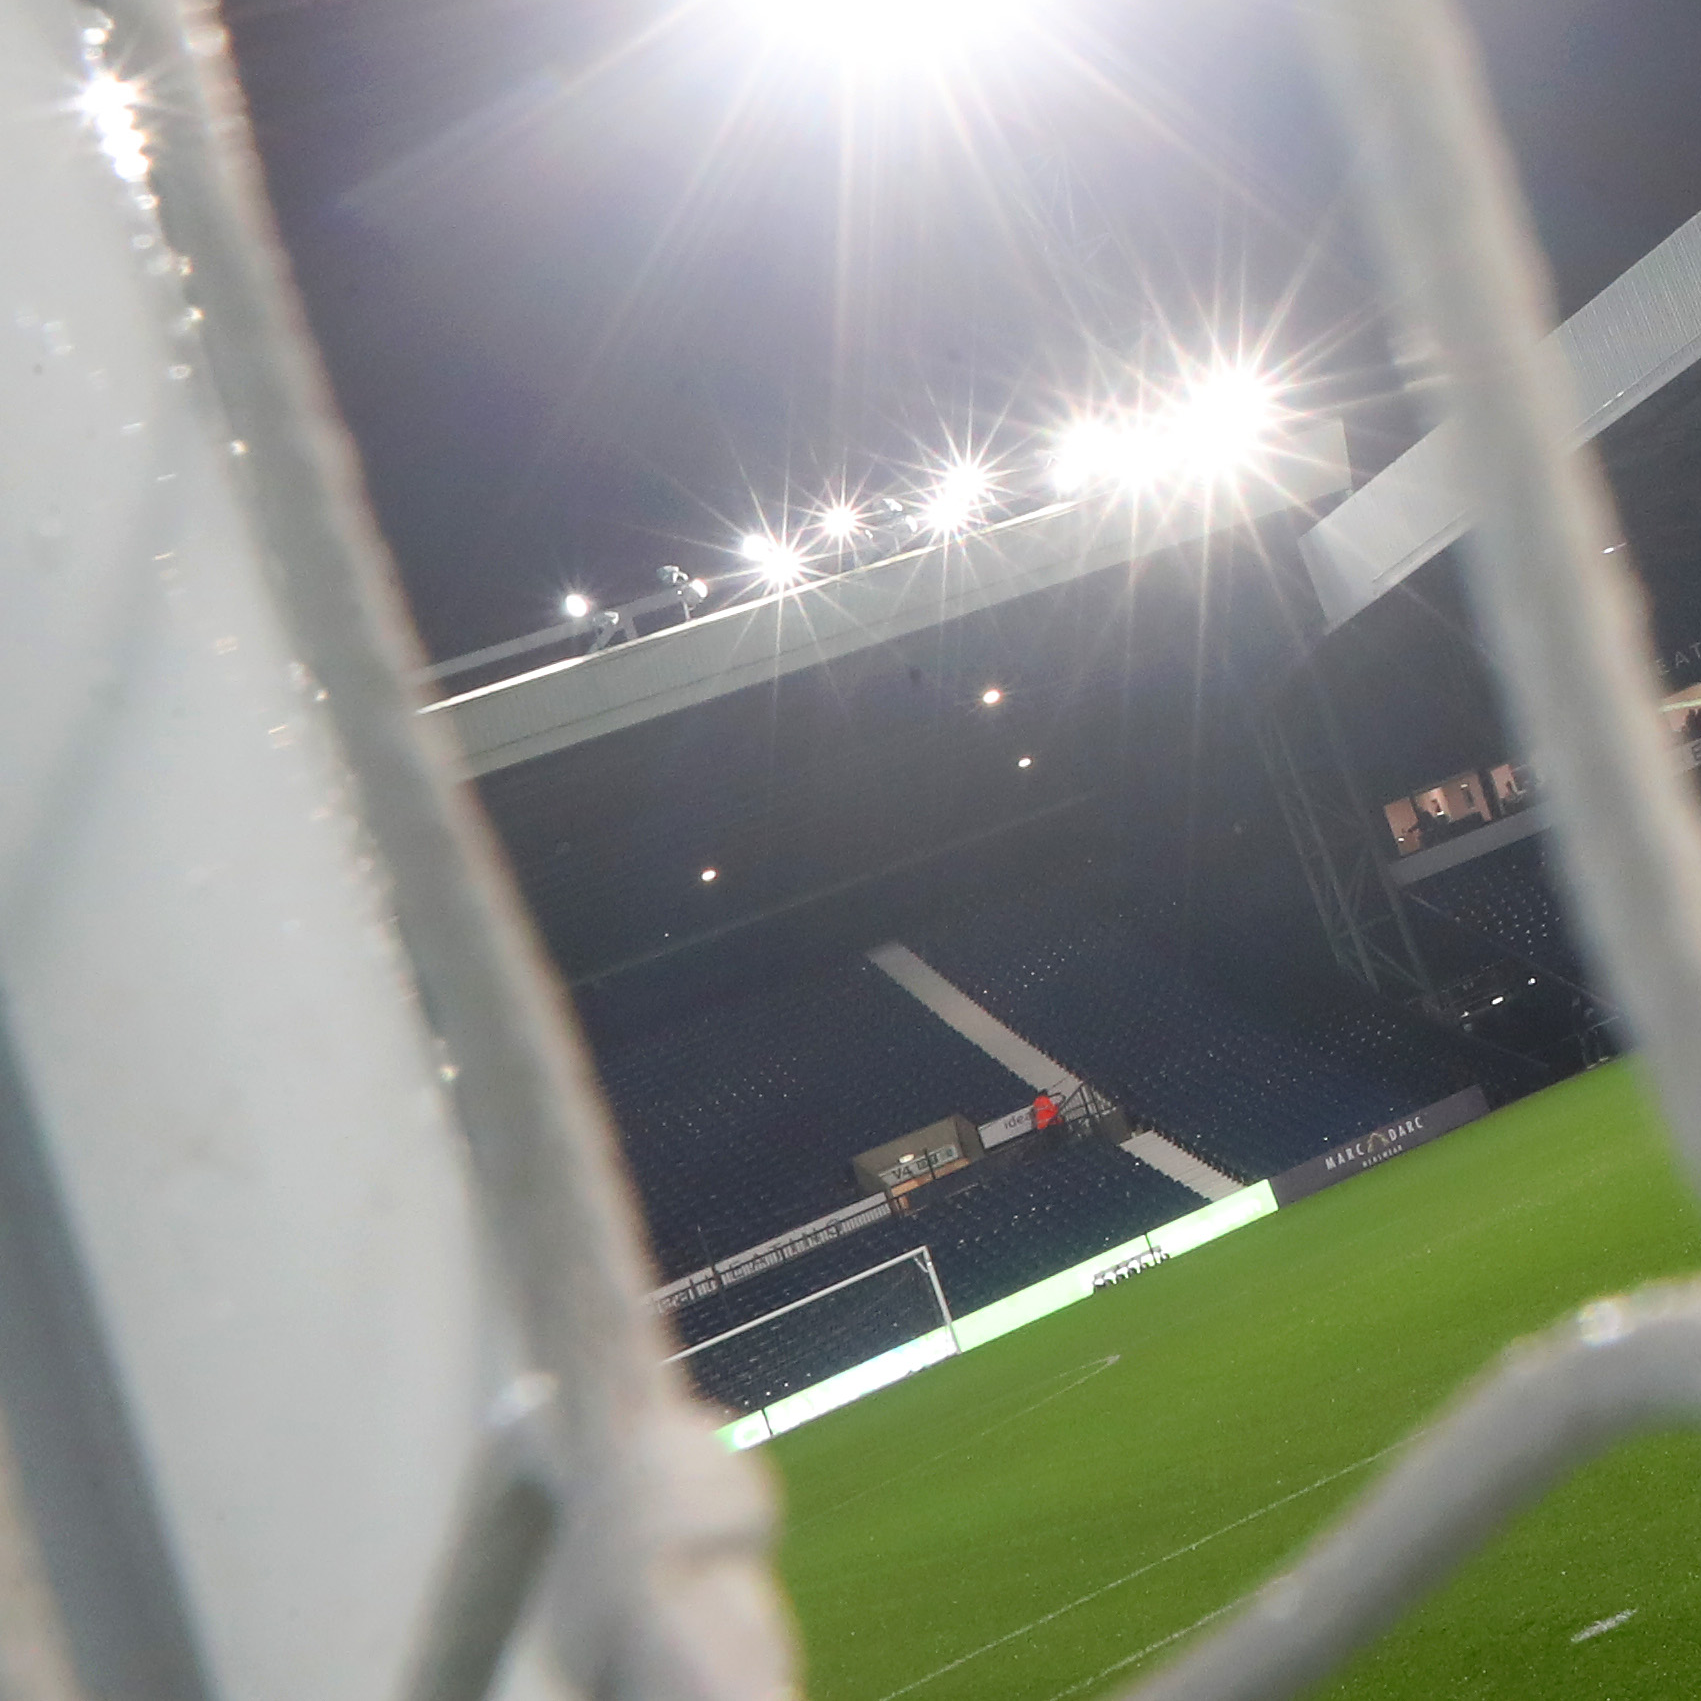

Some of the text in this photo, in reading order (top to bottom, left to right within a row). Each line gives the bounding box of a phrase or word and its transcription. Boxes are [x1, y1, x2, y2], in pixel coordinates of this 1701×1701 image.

[1324, 1116, 1424, 1171] MARC DARC
[892, 1165, 914, 1180] V4
